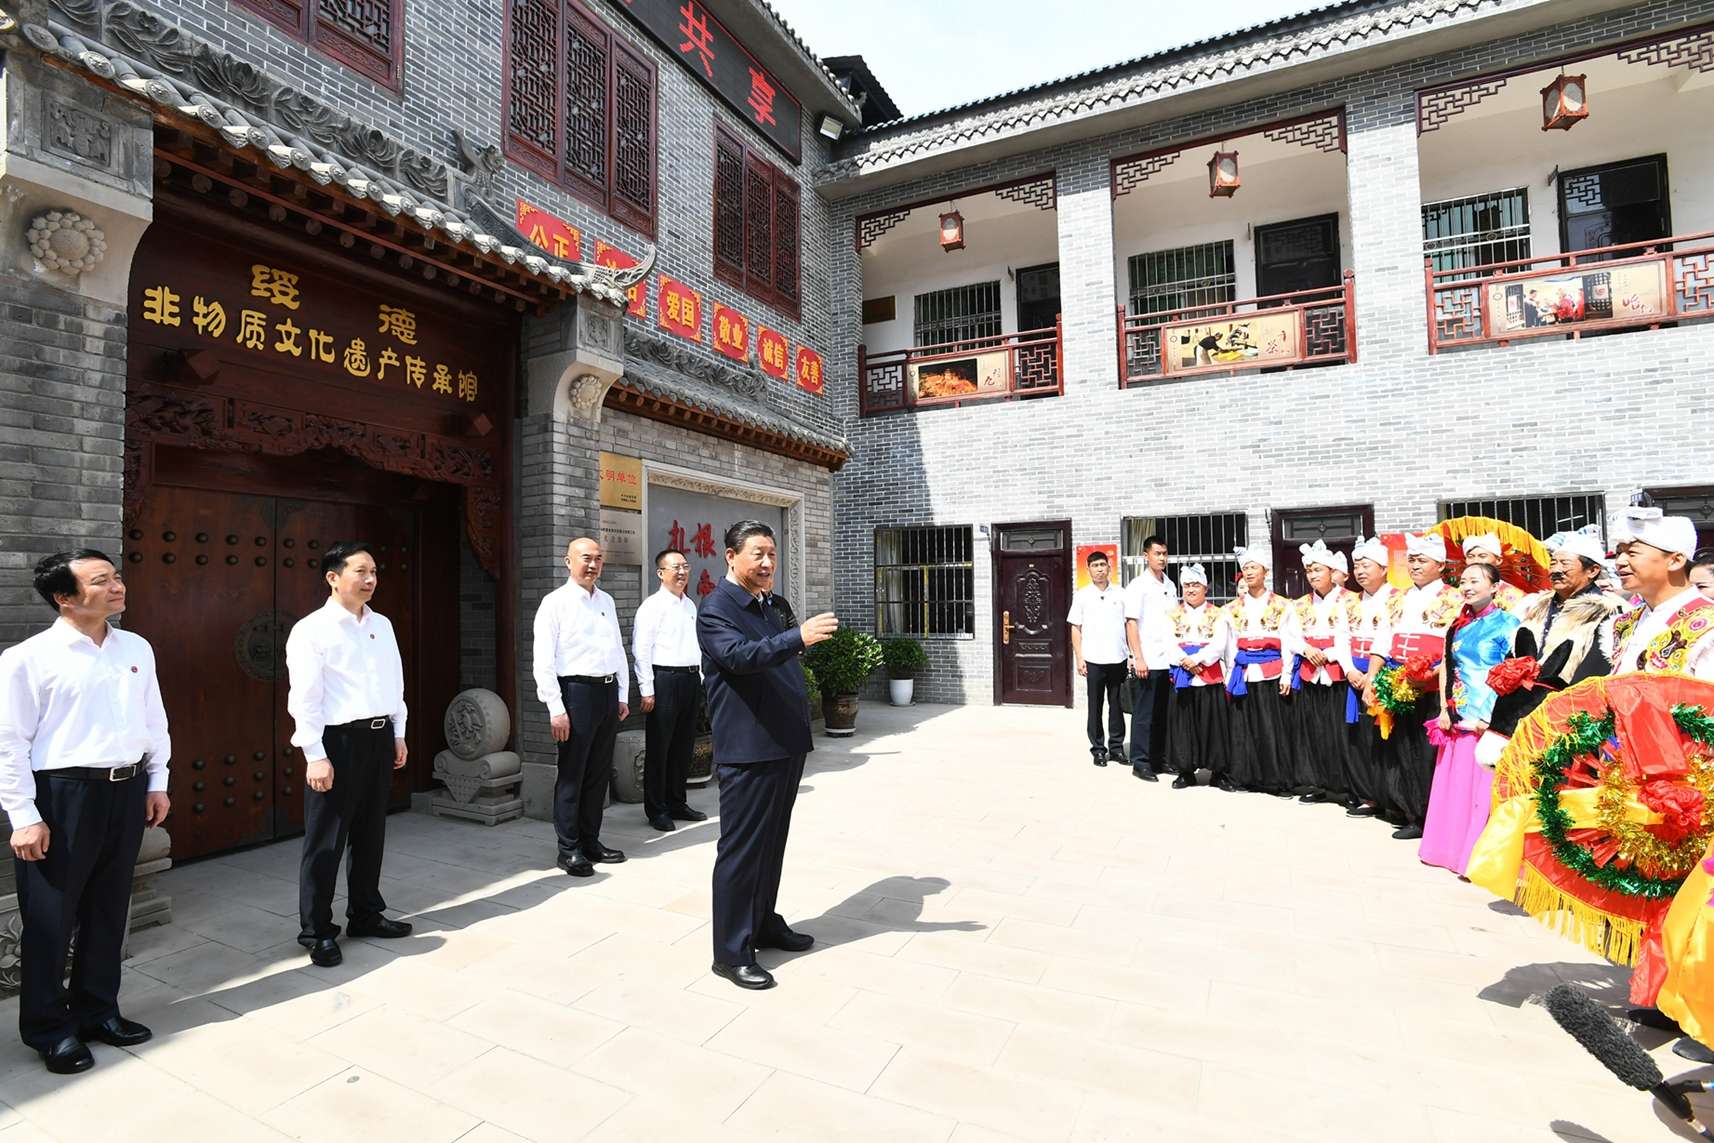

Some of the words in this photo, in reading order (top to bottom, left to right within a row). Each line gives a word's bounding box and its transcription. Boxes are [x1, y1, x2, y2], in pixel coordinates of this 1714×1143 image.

[529, 224, 570, 258] 公正
[250, 264, 418, 345] 绥德
[666, 290, 695, 328] 爱国
[143, 285, 478, 402] 非物质文化遗产传承馆
[718, 315, 744, 351] 敬业
[762, 338, 784, 369] 诚信
[800, 356, 819, 385] 友善
